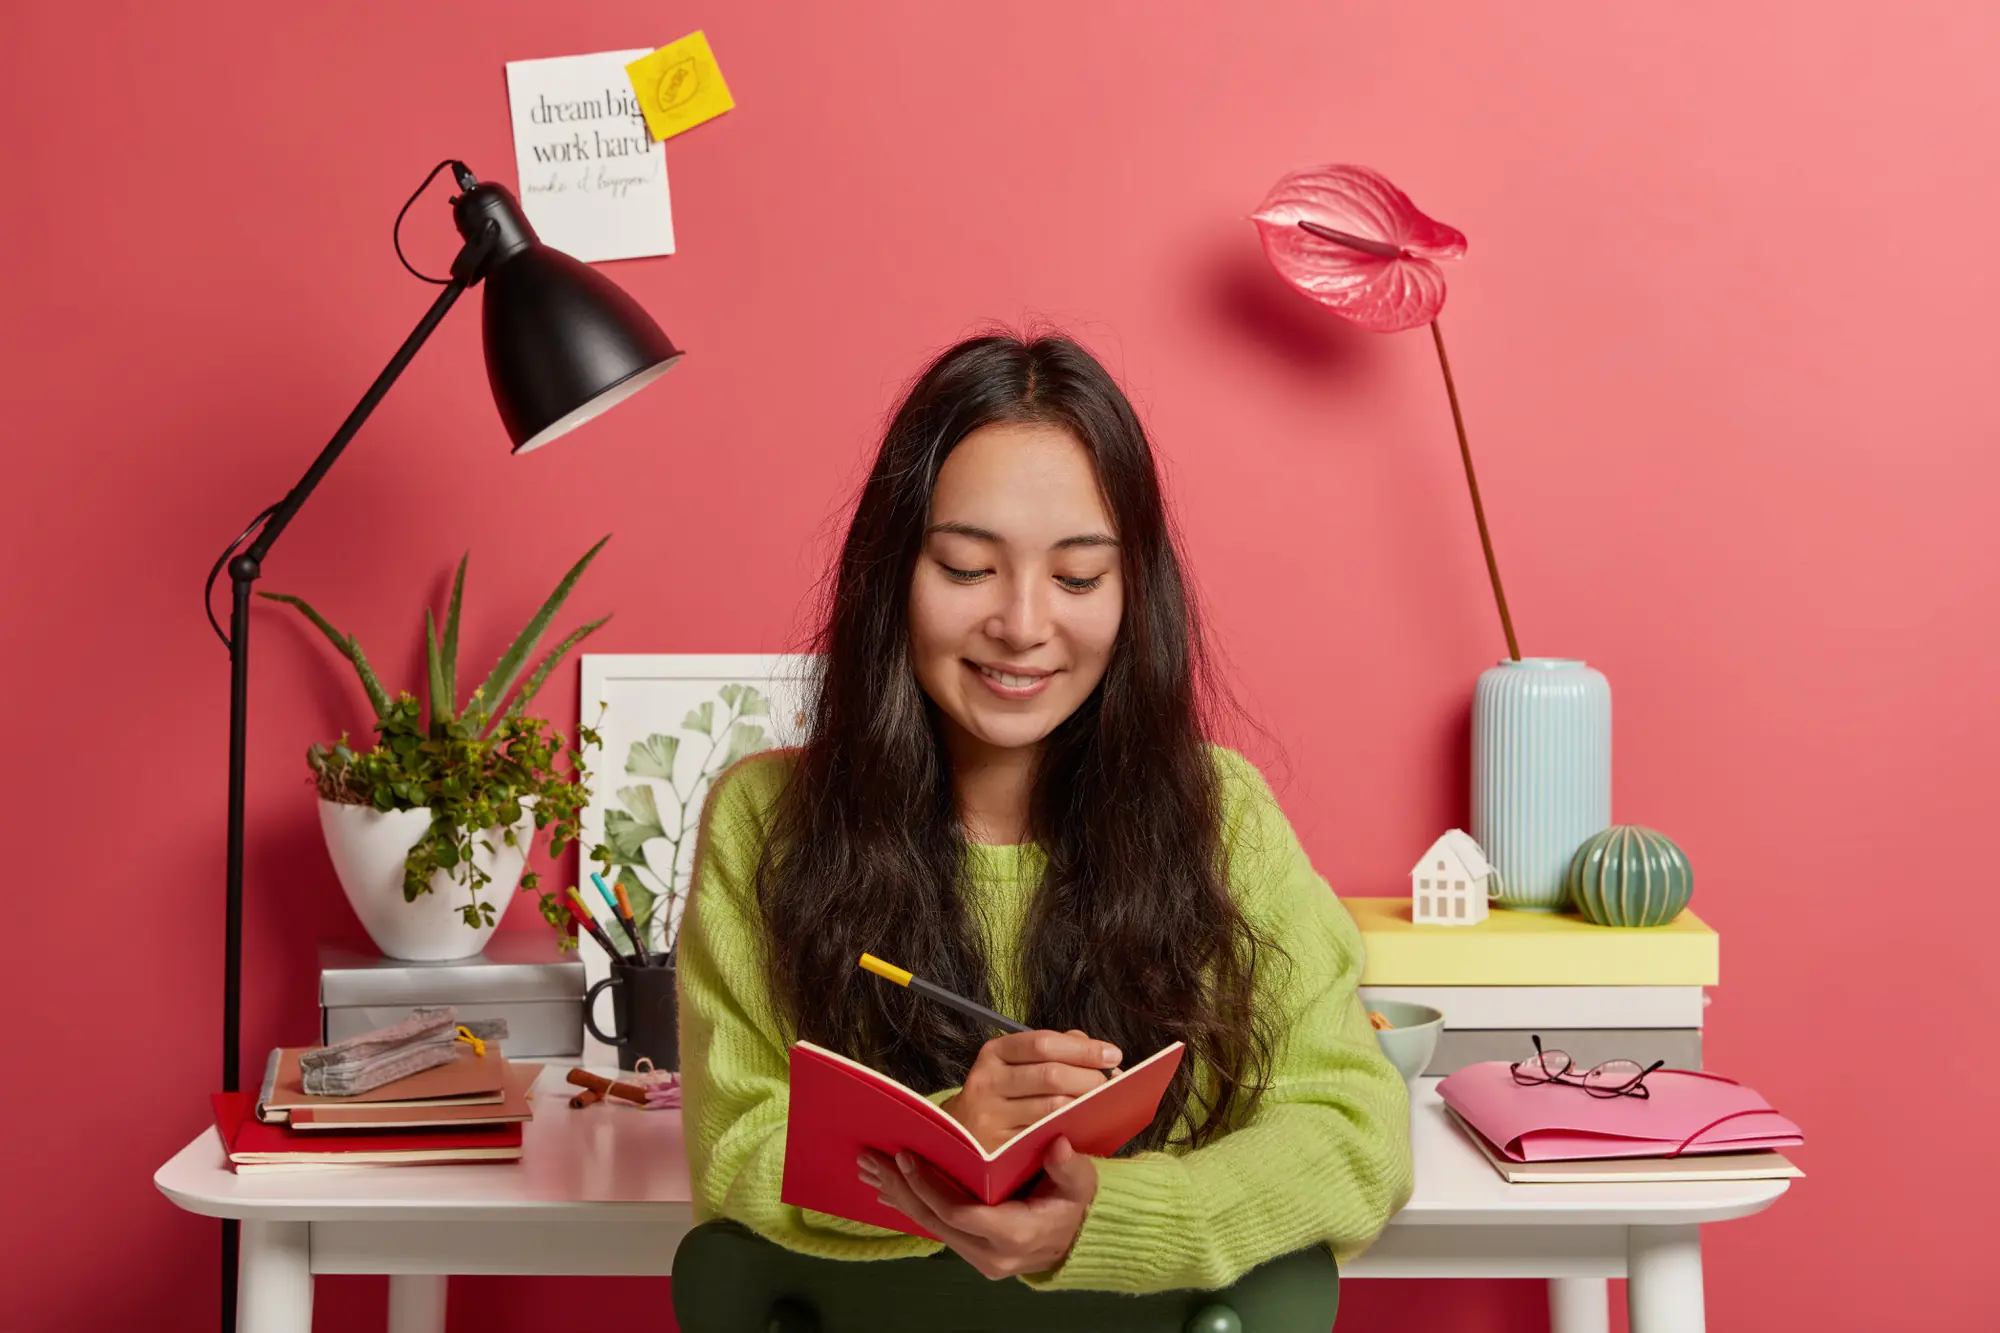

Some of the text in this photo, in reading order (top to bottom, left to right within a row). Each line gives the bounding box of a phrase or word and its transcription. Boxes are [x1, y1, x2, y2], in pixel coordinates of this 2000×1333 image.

[531, 94, 602, 124] dream
[533, 125, 650, 164] work hard
[577, 165, 590, 193] it
